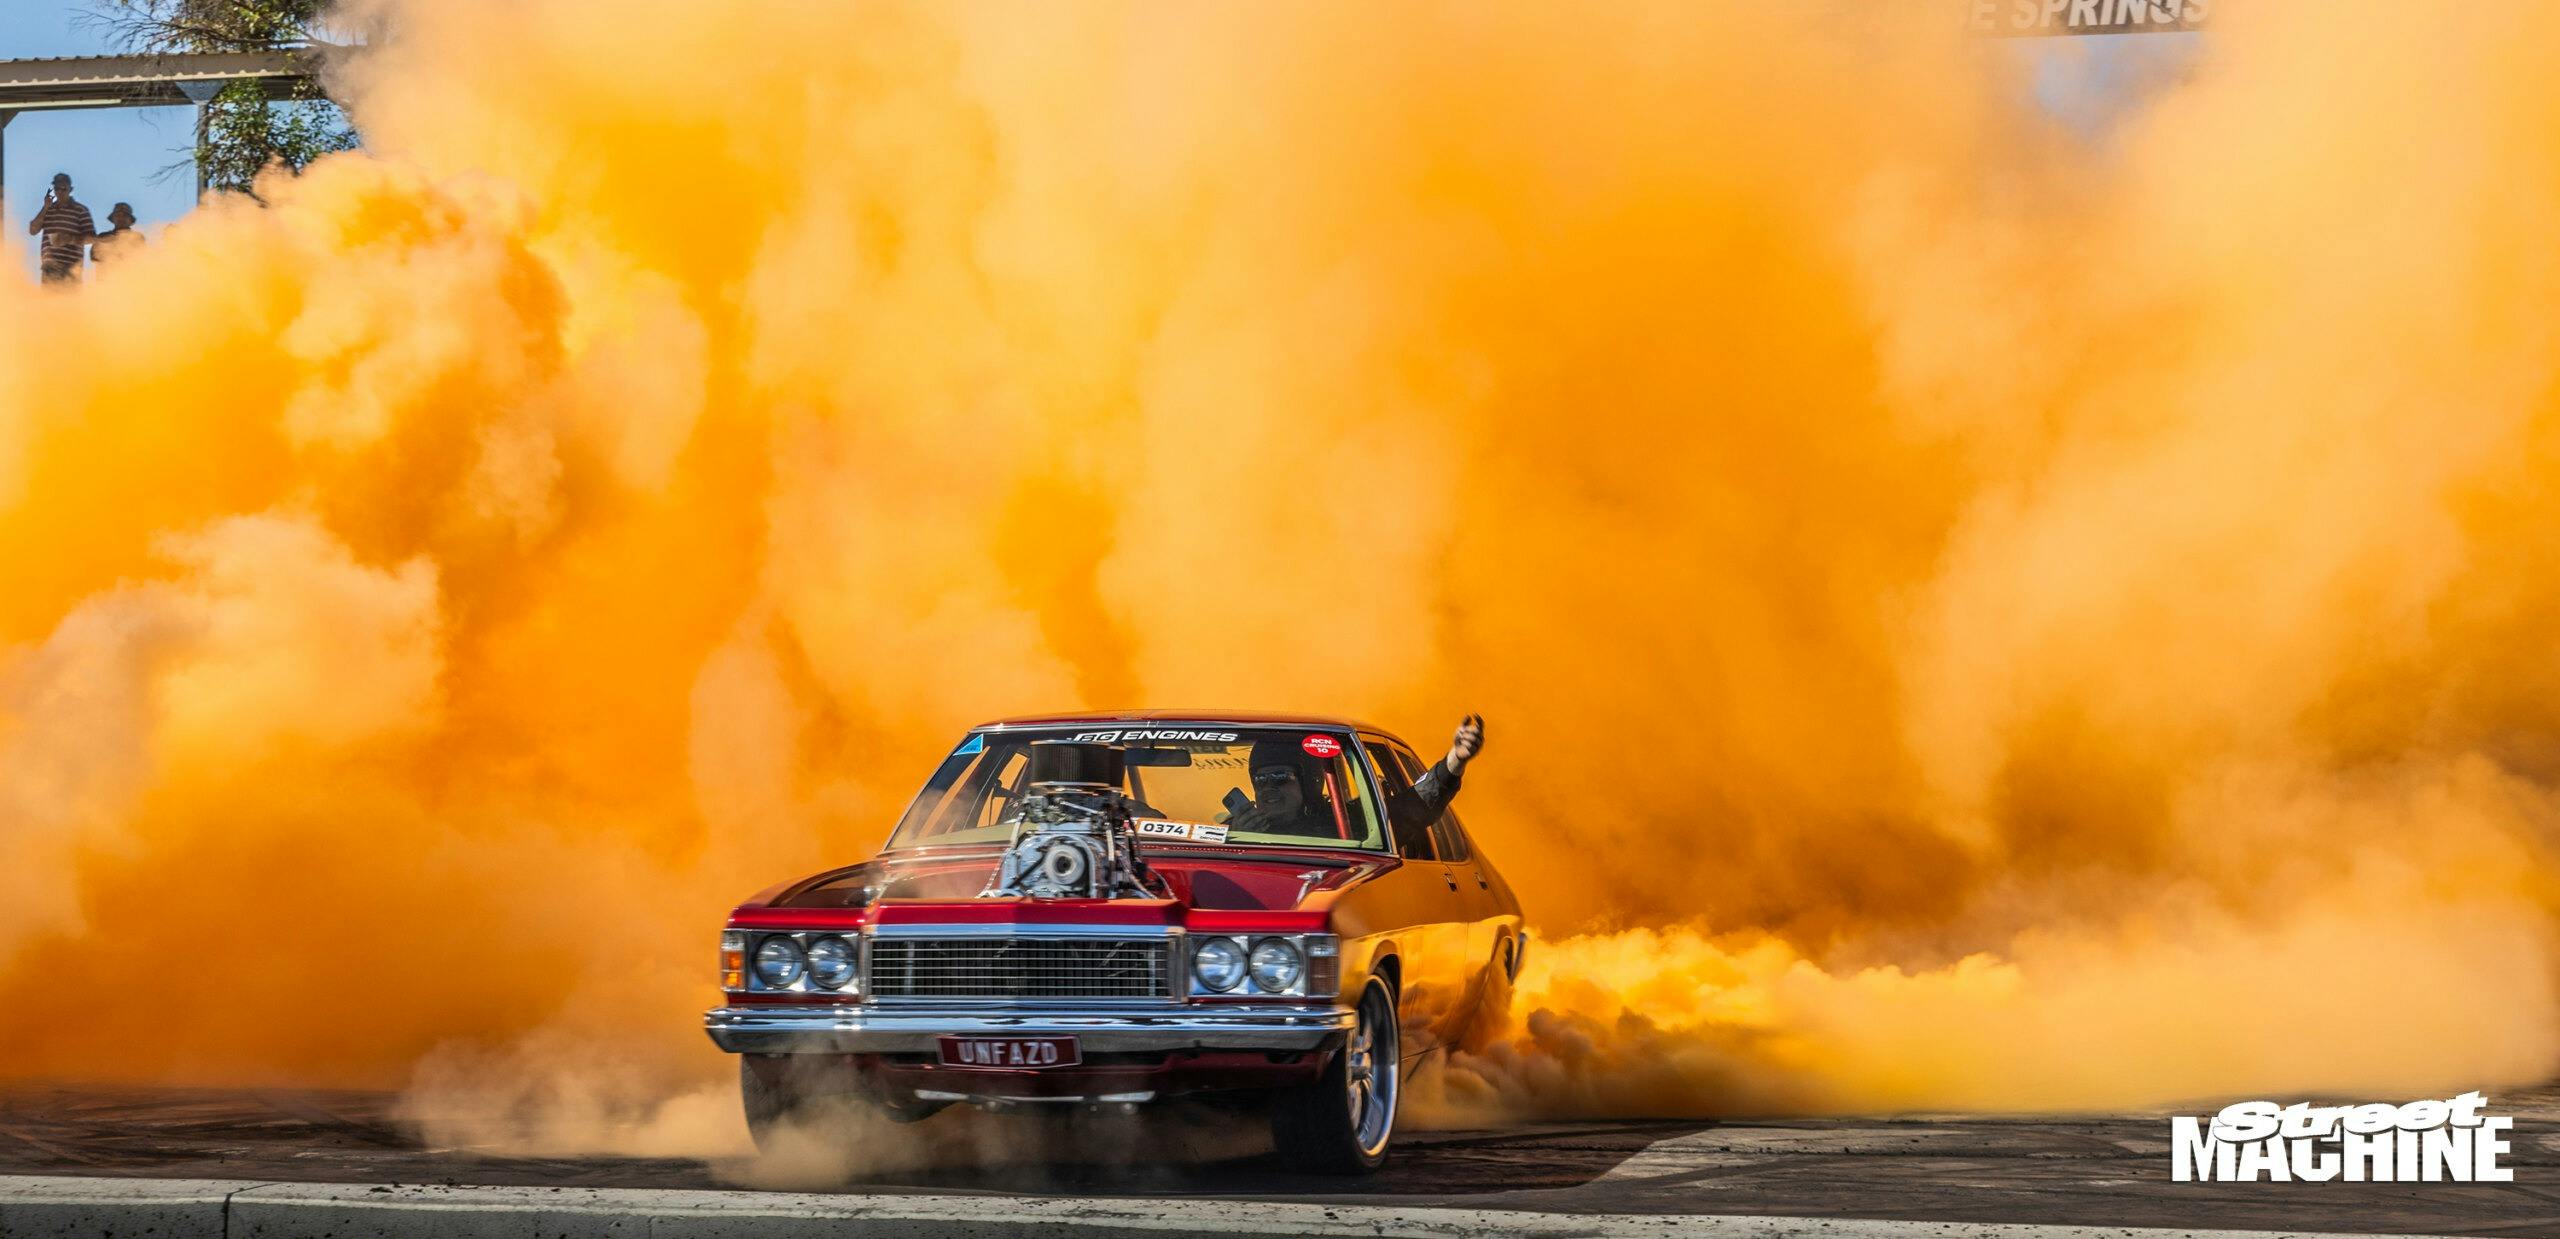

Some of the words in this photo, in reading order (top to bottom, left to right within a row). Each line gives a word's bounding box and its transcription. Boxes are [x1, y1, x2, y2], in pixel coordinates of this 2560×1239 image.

[2010, 0, 2209, 29] SPRINGS
[1122, 730, 1238, 741] ENGINES
[1143, 823, 1184, 835] 0374
[957, 1042, 1058, 1065] UNFAZD
